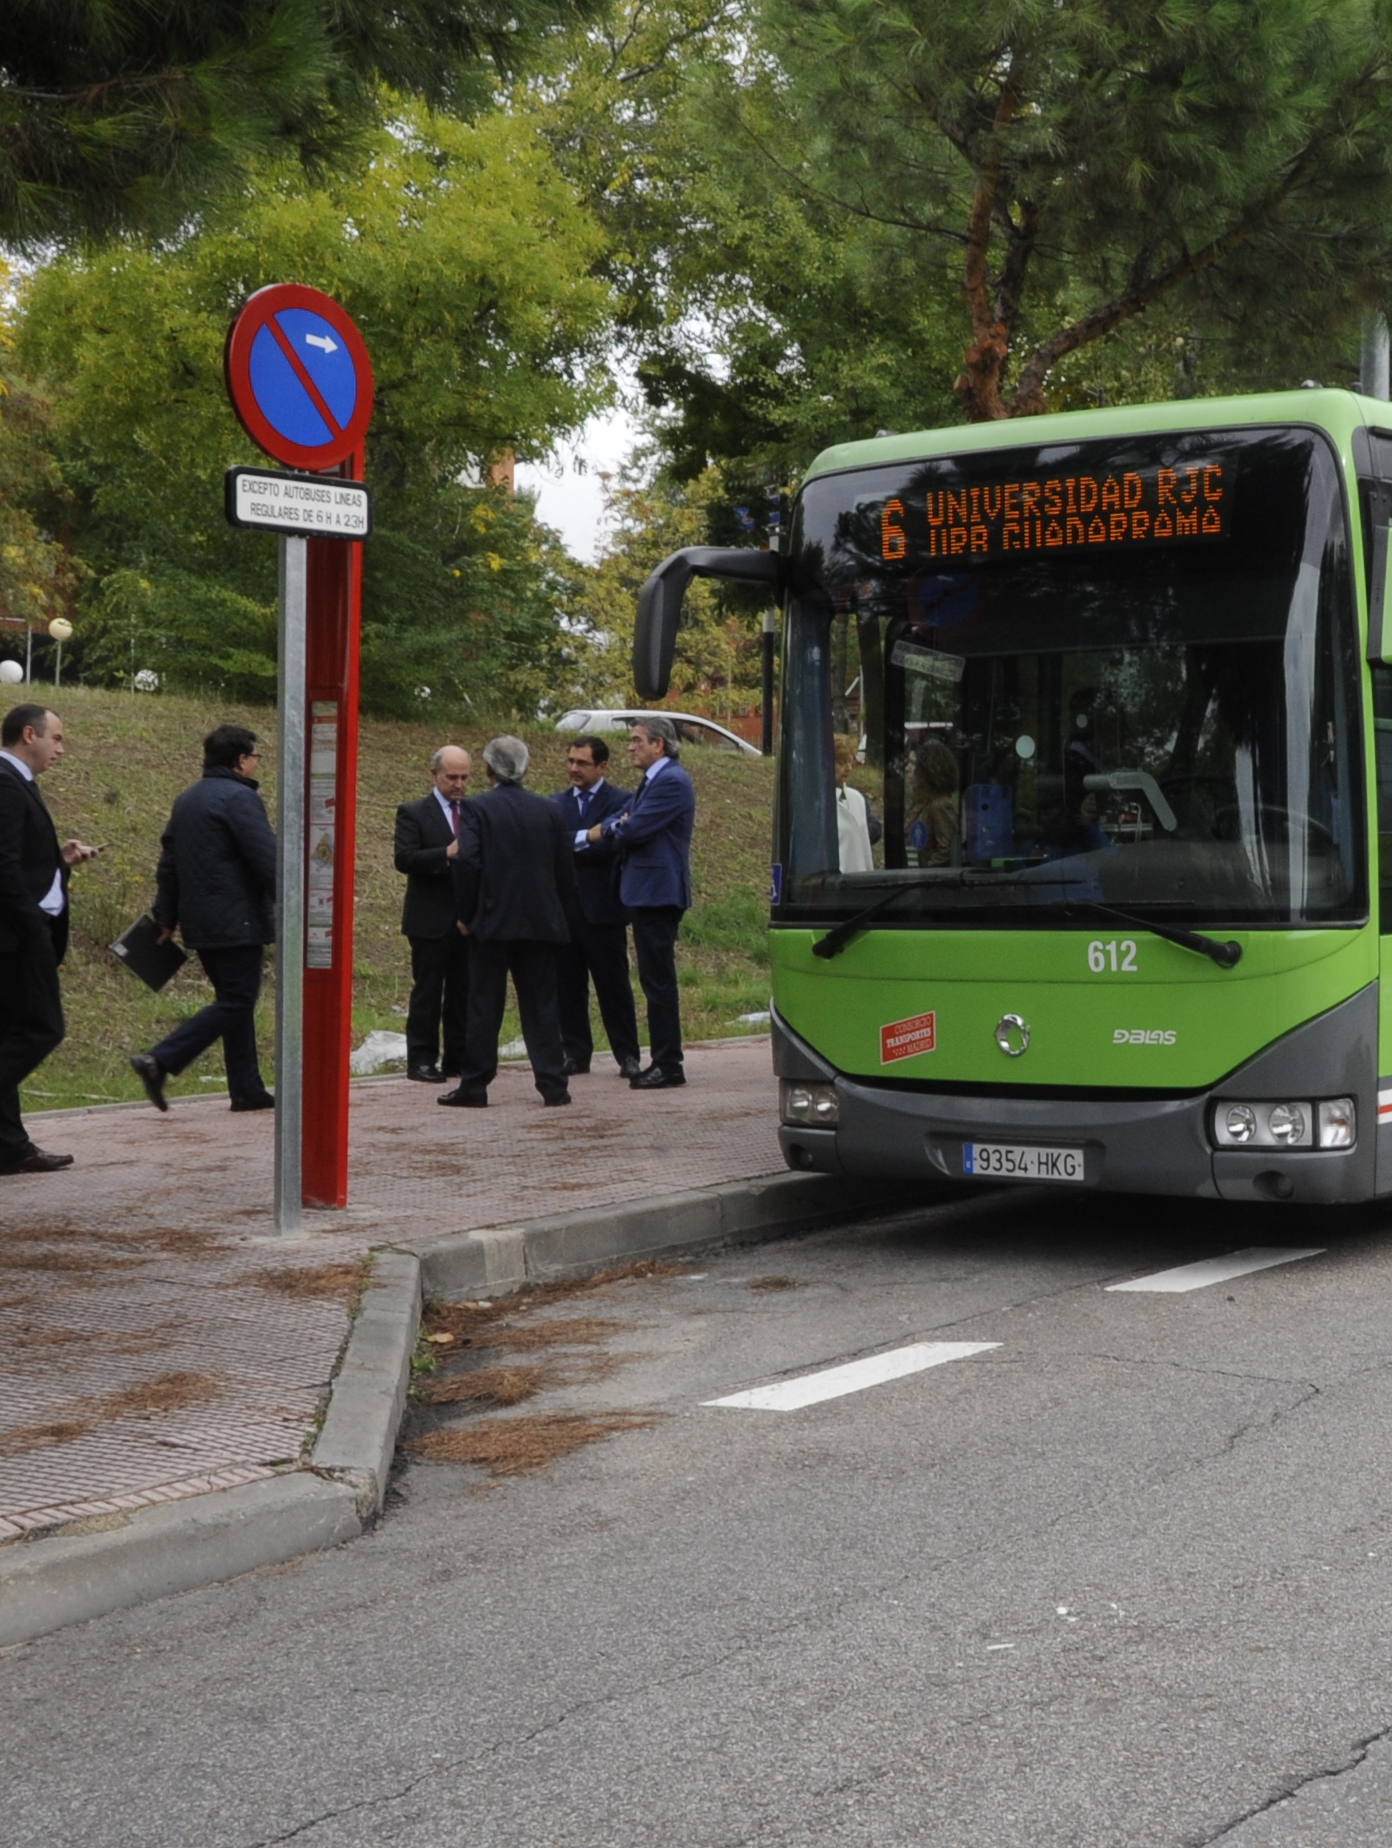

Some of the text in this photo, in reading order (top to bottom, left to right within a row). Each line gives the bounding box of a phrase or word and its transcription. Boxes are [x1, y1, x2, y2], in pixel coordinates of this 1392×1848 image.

[242, 479, 362, 508] EXCEPTO AUTOBUSES LINEAS
[926, 464, 1223, 527] UNIVERSIDAD RJC
[250, 502, 299, 521] REGULARES
[303, 509, 314, 523] DE
[316, 510, 324, 523] 6
[335, 513, 341, 526] A
[881, 499, 905, 560] 6
[1087, 940, 1138, 973] 612
[979, 1148, 1028, 1174] 9354
[1037, 1152, 1076, 1177] HKG
